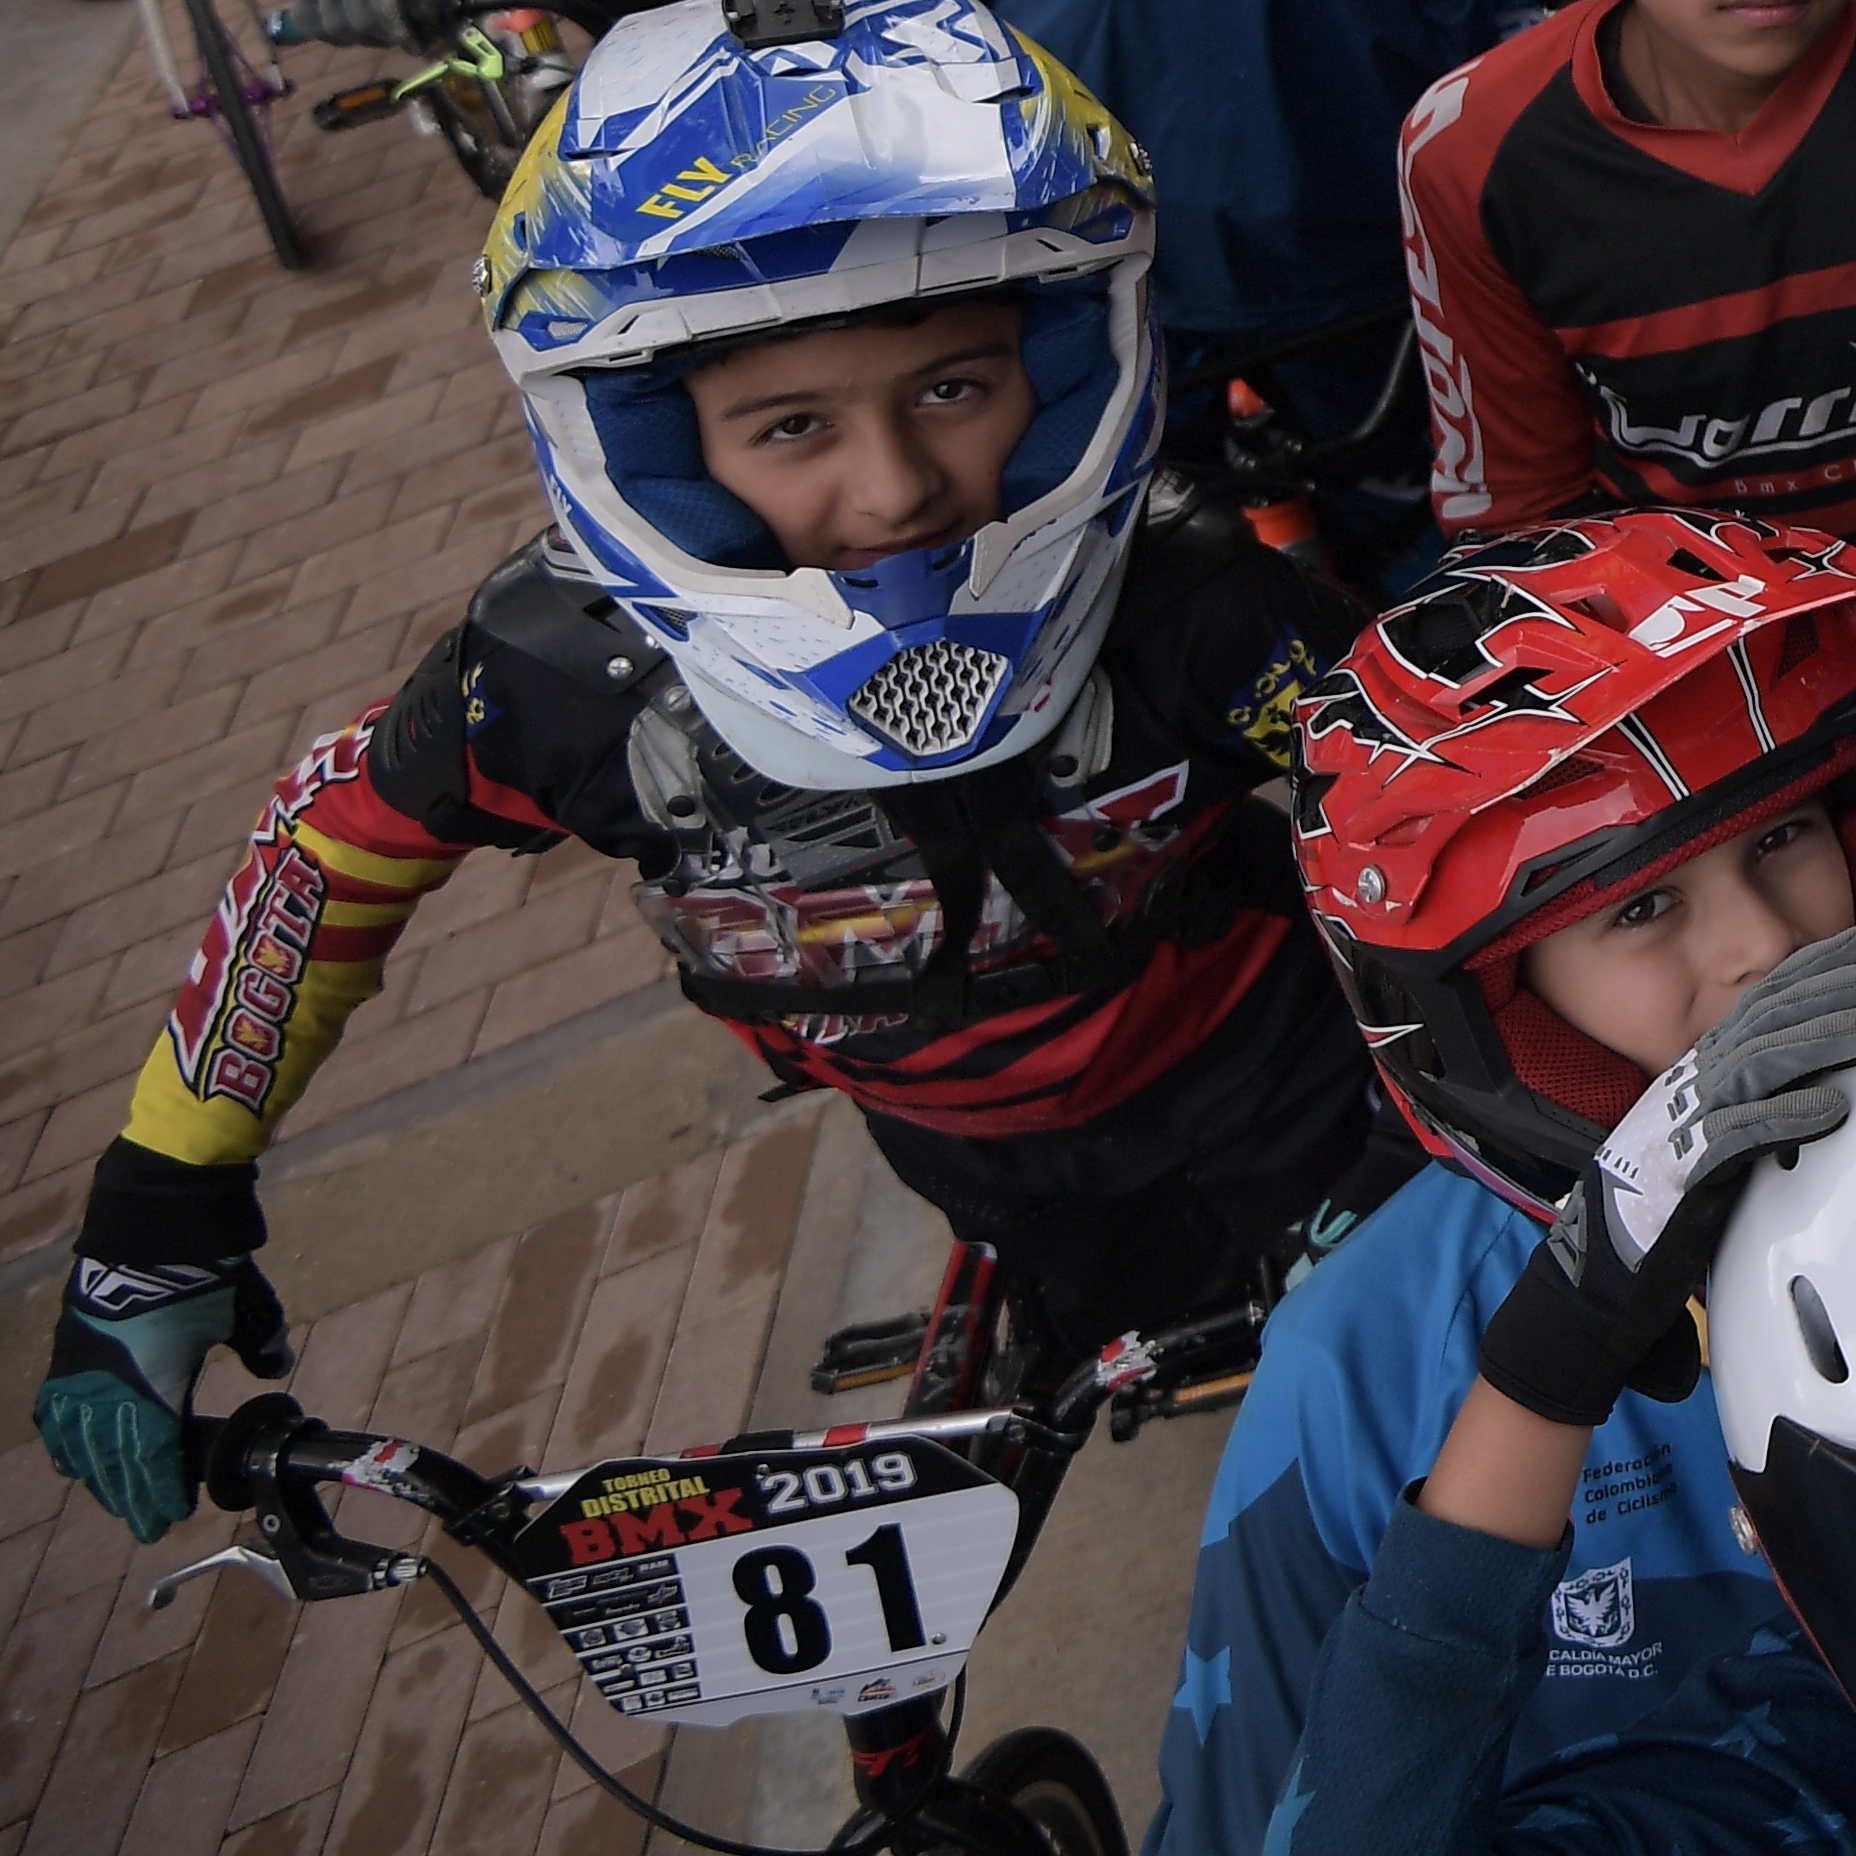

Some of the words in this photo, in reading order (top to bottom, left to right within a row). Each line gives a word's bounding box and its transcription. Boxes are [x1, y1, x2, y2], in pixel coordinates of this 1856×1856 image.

[636, 157, 733, 219] FLY
[731, 85, 837, 169] RACING
[206, 841, 328, 1118] BOGOTA
[580, 1476, 711, 1520] DISTRITAL
[762, 1451, 917, 1515] 2019
[601, 1468, 671, 1495] TORNEO
[1586, 1507, 1607, 1525] de
[559, 1487, 754, 1566] BMX
[731, 1521, 928, 1675] 81
[1549, 1648, 1607, 1664] CALDÍA
[1608, 1640, 1664, 1667] MAYOR
